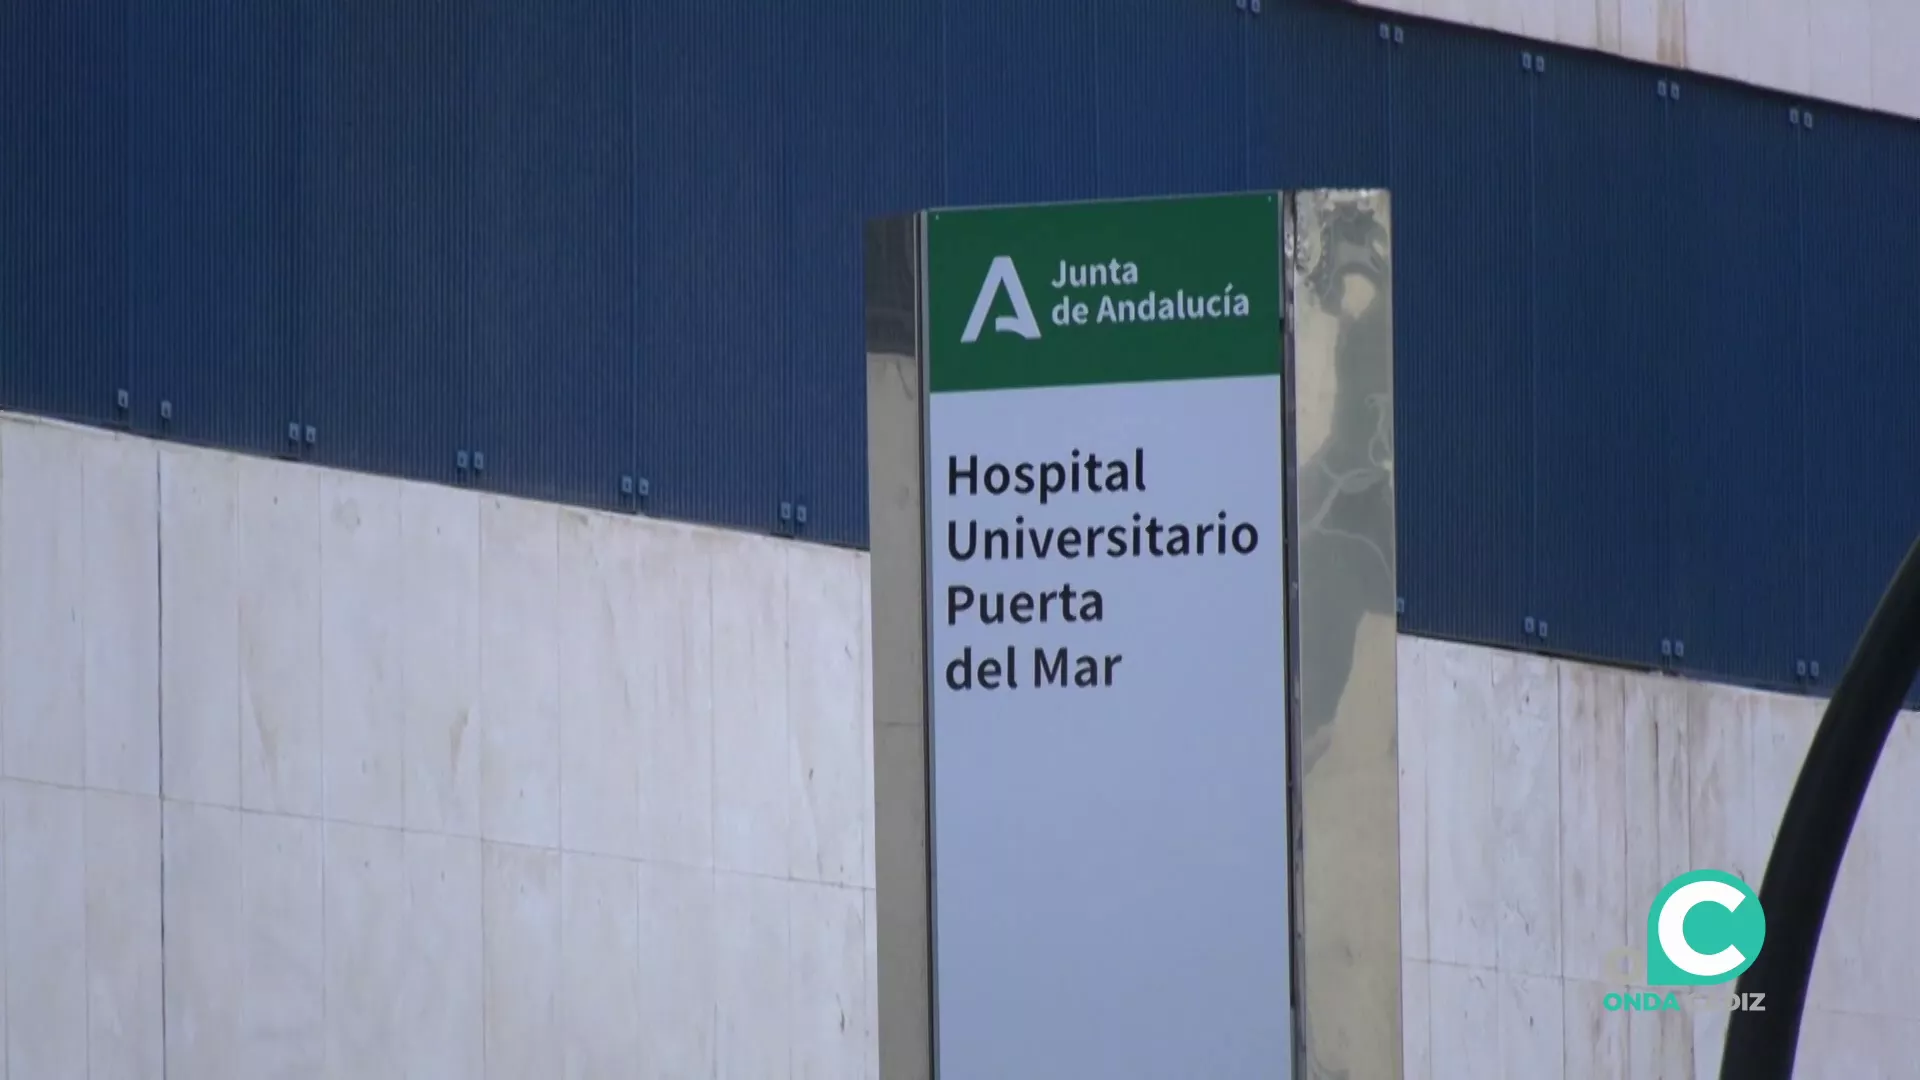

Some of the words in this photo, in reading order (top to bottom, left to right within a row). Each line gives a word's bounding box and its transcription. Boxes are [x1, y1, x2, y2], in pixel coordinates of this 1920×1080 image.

[1051, 258, 1139, 289] Junta
[1051, 295, 1089, 326] de
[1096, 283, 1250, 324] Andalucía
[948, 447, 1146, 505] Hospital
[948, 510, 1259, 562] Universitario
[947, 583, 1103, 626] Puerta
[945, 645, 1018, 691] del
[1033, 646, 1123, 688] Mar
